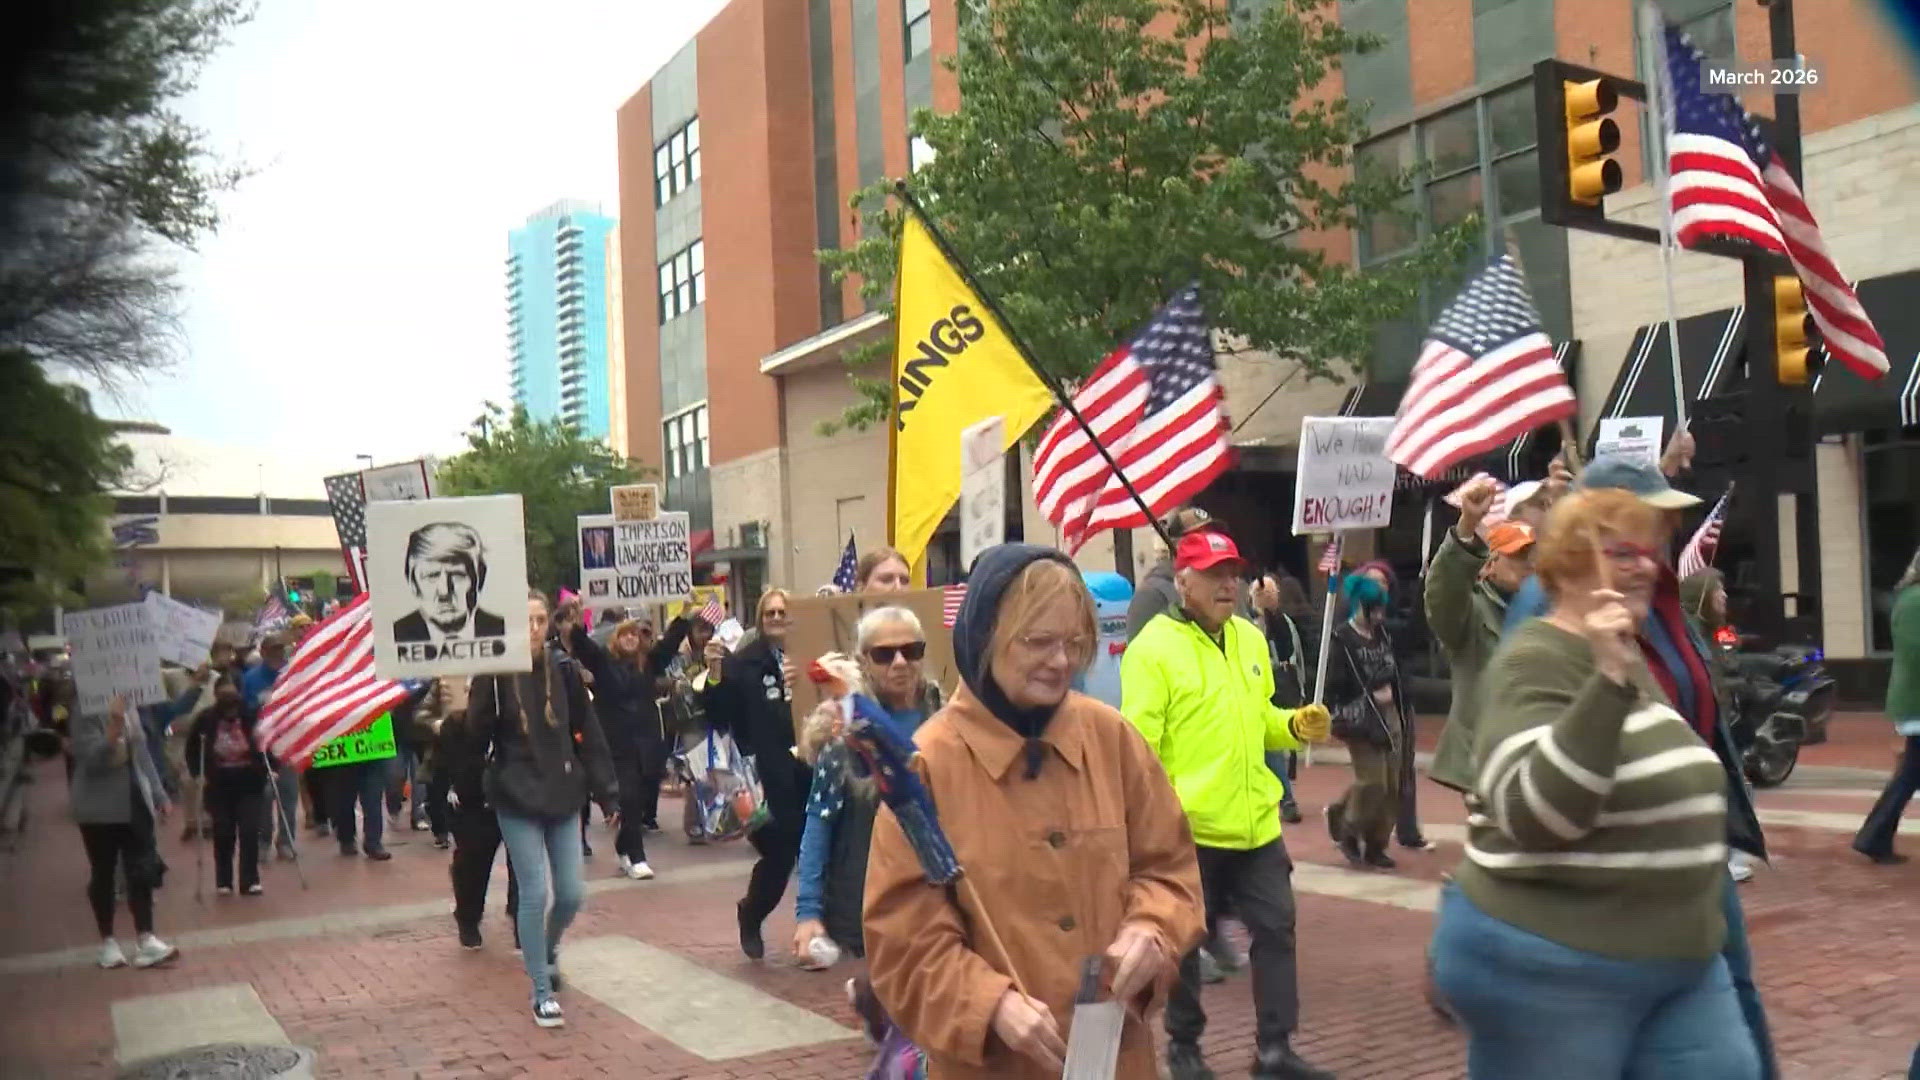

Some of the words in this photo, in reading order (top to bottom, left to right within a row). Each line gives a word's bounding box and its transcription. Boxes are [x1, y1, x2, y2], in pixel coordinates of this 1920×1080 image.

[1312, 423, 1343, 455] We
[1337, 462, 1373, 486] HAD
[1303, 493, 1386, 524] ENOUGH!
[616, 572, 690, 598] KIDNAPPERS
[397, 640, 506, 662] REDACTED
